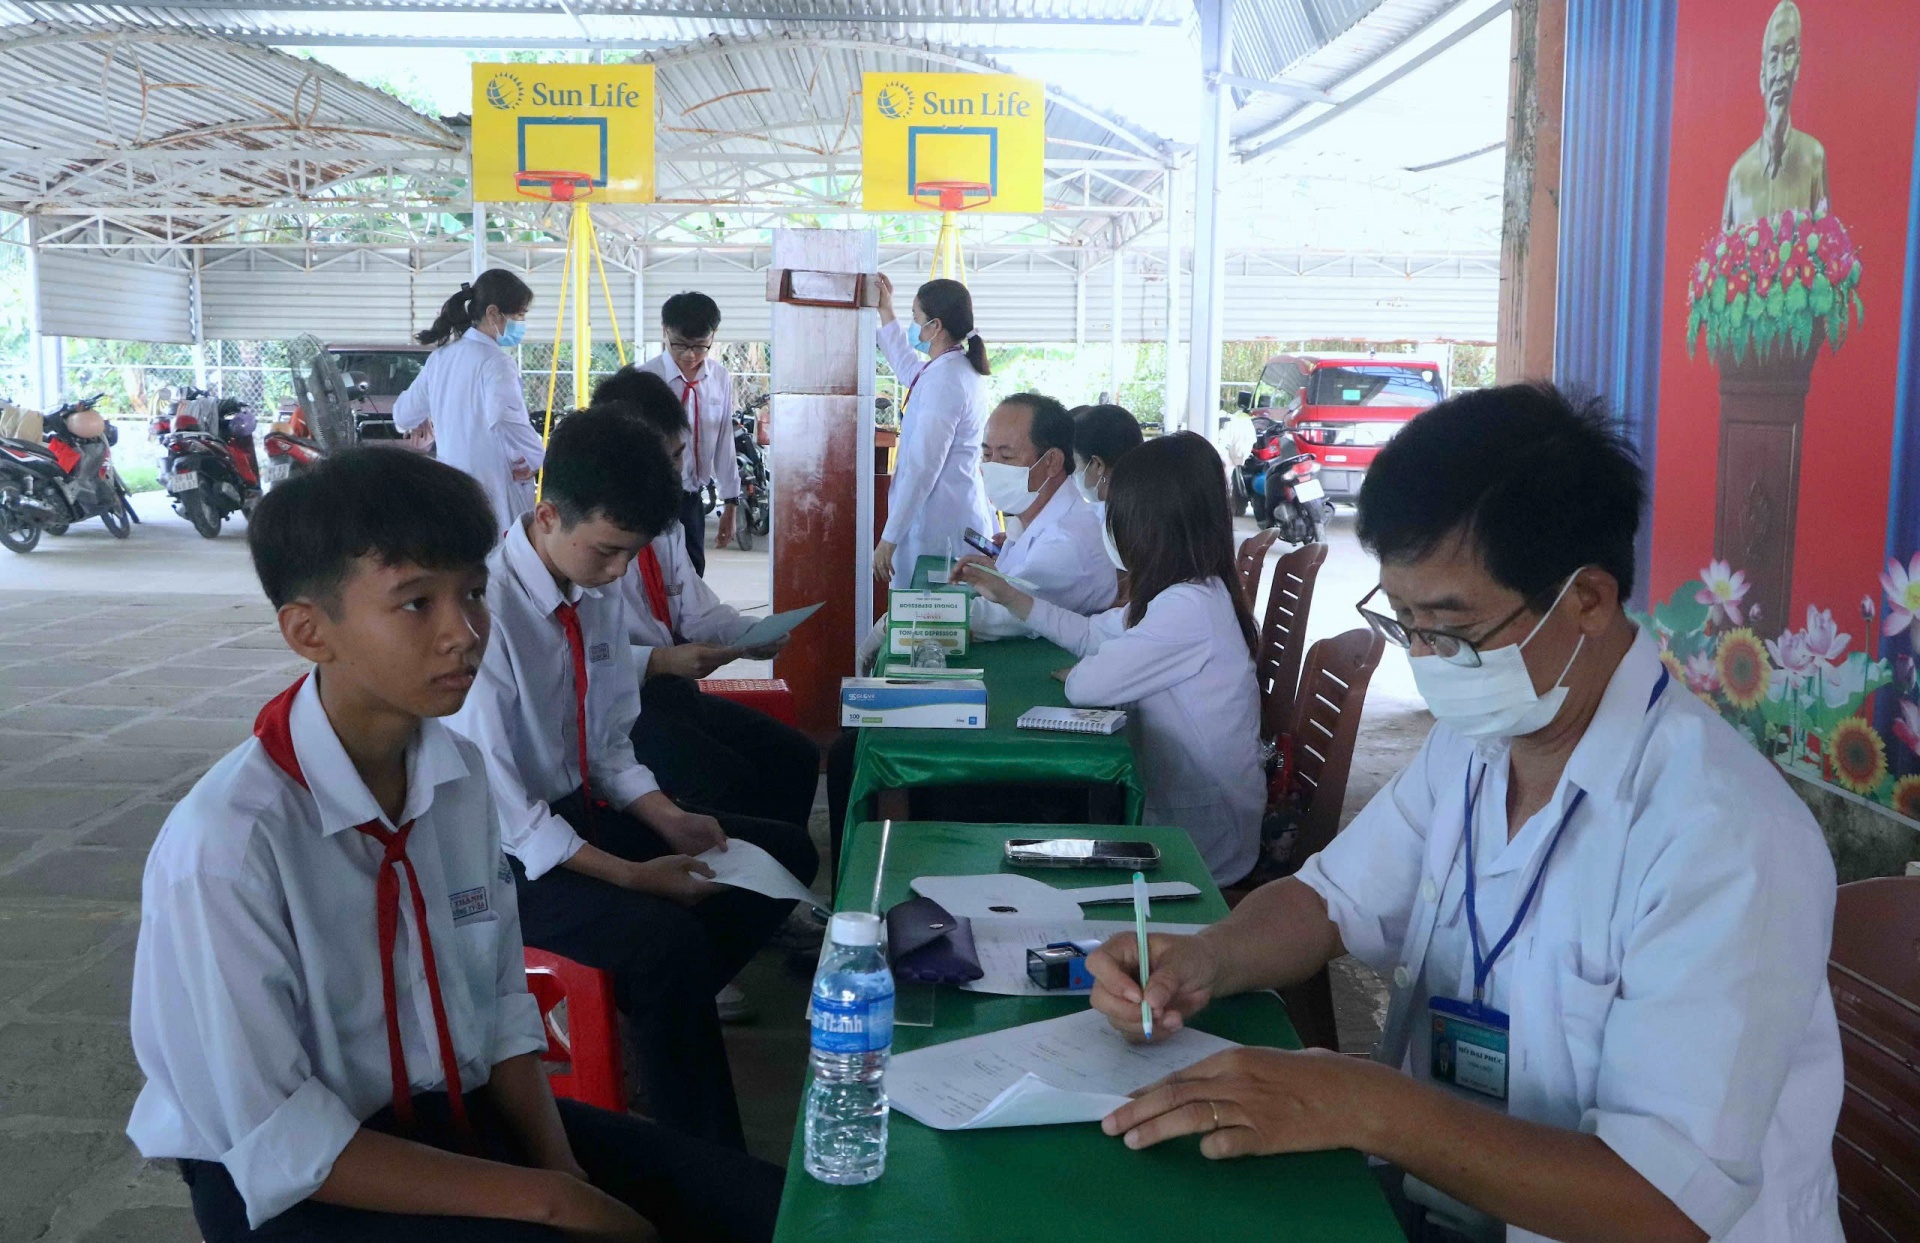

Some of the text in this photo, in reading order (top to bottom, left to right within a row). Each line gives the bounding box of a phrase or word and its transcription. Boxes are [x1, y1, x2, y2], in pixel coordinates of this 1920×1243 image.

[532, 82, 640, 108] Sun Life
[923, 91, 1031, 117] Sun Life
